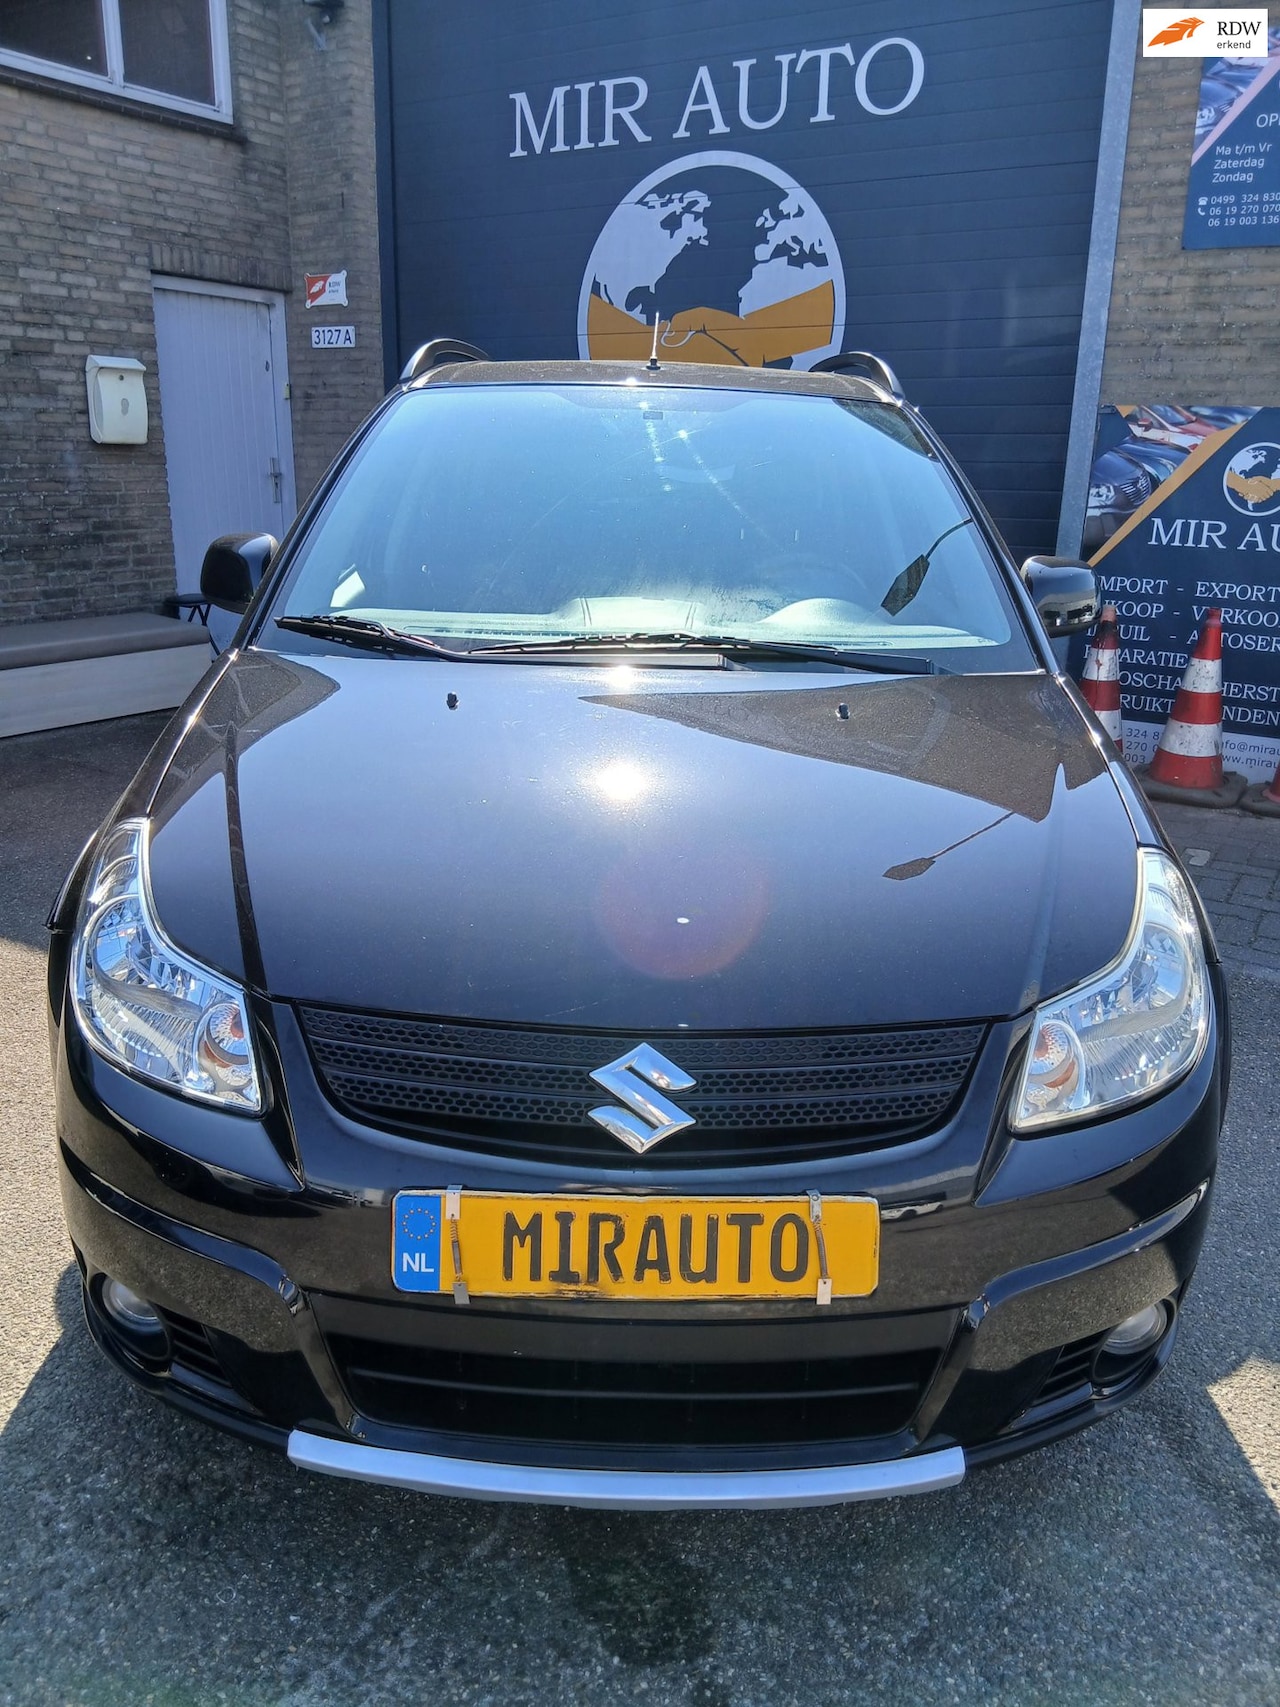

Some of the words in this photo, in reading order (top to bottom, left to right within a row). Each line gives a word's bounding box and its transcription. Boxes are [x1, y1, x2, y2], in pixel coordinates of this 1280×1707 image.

[509, 76, 652, 157] MIR
[673, 37, 925, 139] AUTO
[1216, 145, 1232, 156] Ma
[1235, 143, 1256, 155] t/m
[1259, 142, 1272, 153] Vr
[1214, 158, 1265, 172] Zaterdag
[1212, 172, 1254, 183] Zondag
[1210, 195, 1235, 205] 0499
[1241, 193, 1259, 203] 324
[1209, 208, 1221, 216] 06
[1226, 207, 1237, 215] 19
[1240, 205, 1259, 214] 270
[1208, 218, 1220, 227] 06
[1224, 217, 1236, 226] 19
[1239, 216, 1257, 225] 003
[1261, 215, 1280, 224] 136
[1148, 517, 1228, 549] MIR
[1098, 575, 1168, 595] MPORT
[1195, 581, 1280, 603] EXPORT
[1192, 605, 1280, 628] VRKOO
[1186, 629, 1280, 653] ATOSER
[1126, 728, 1148, 739] 324
[1126, 741, 1148, 752] 270
[503, 1210, 810, 1285] MIRAUTO
[402, 1252, 434, 1273] NL
